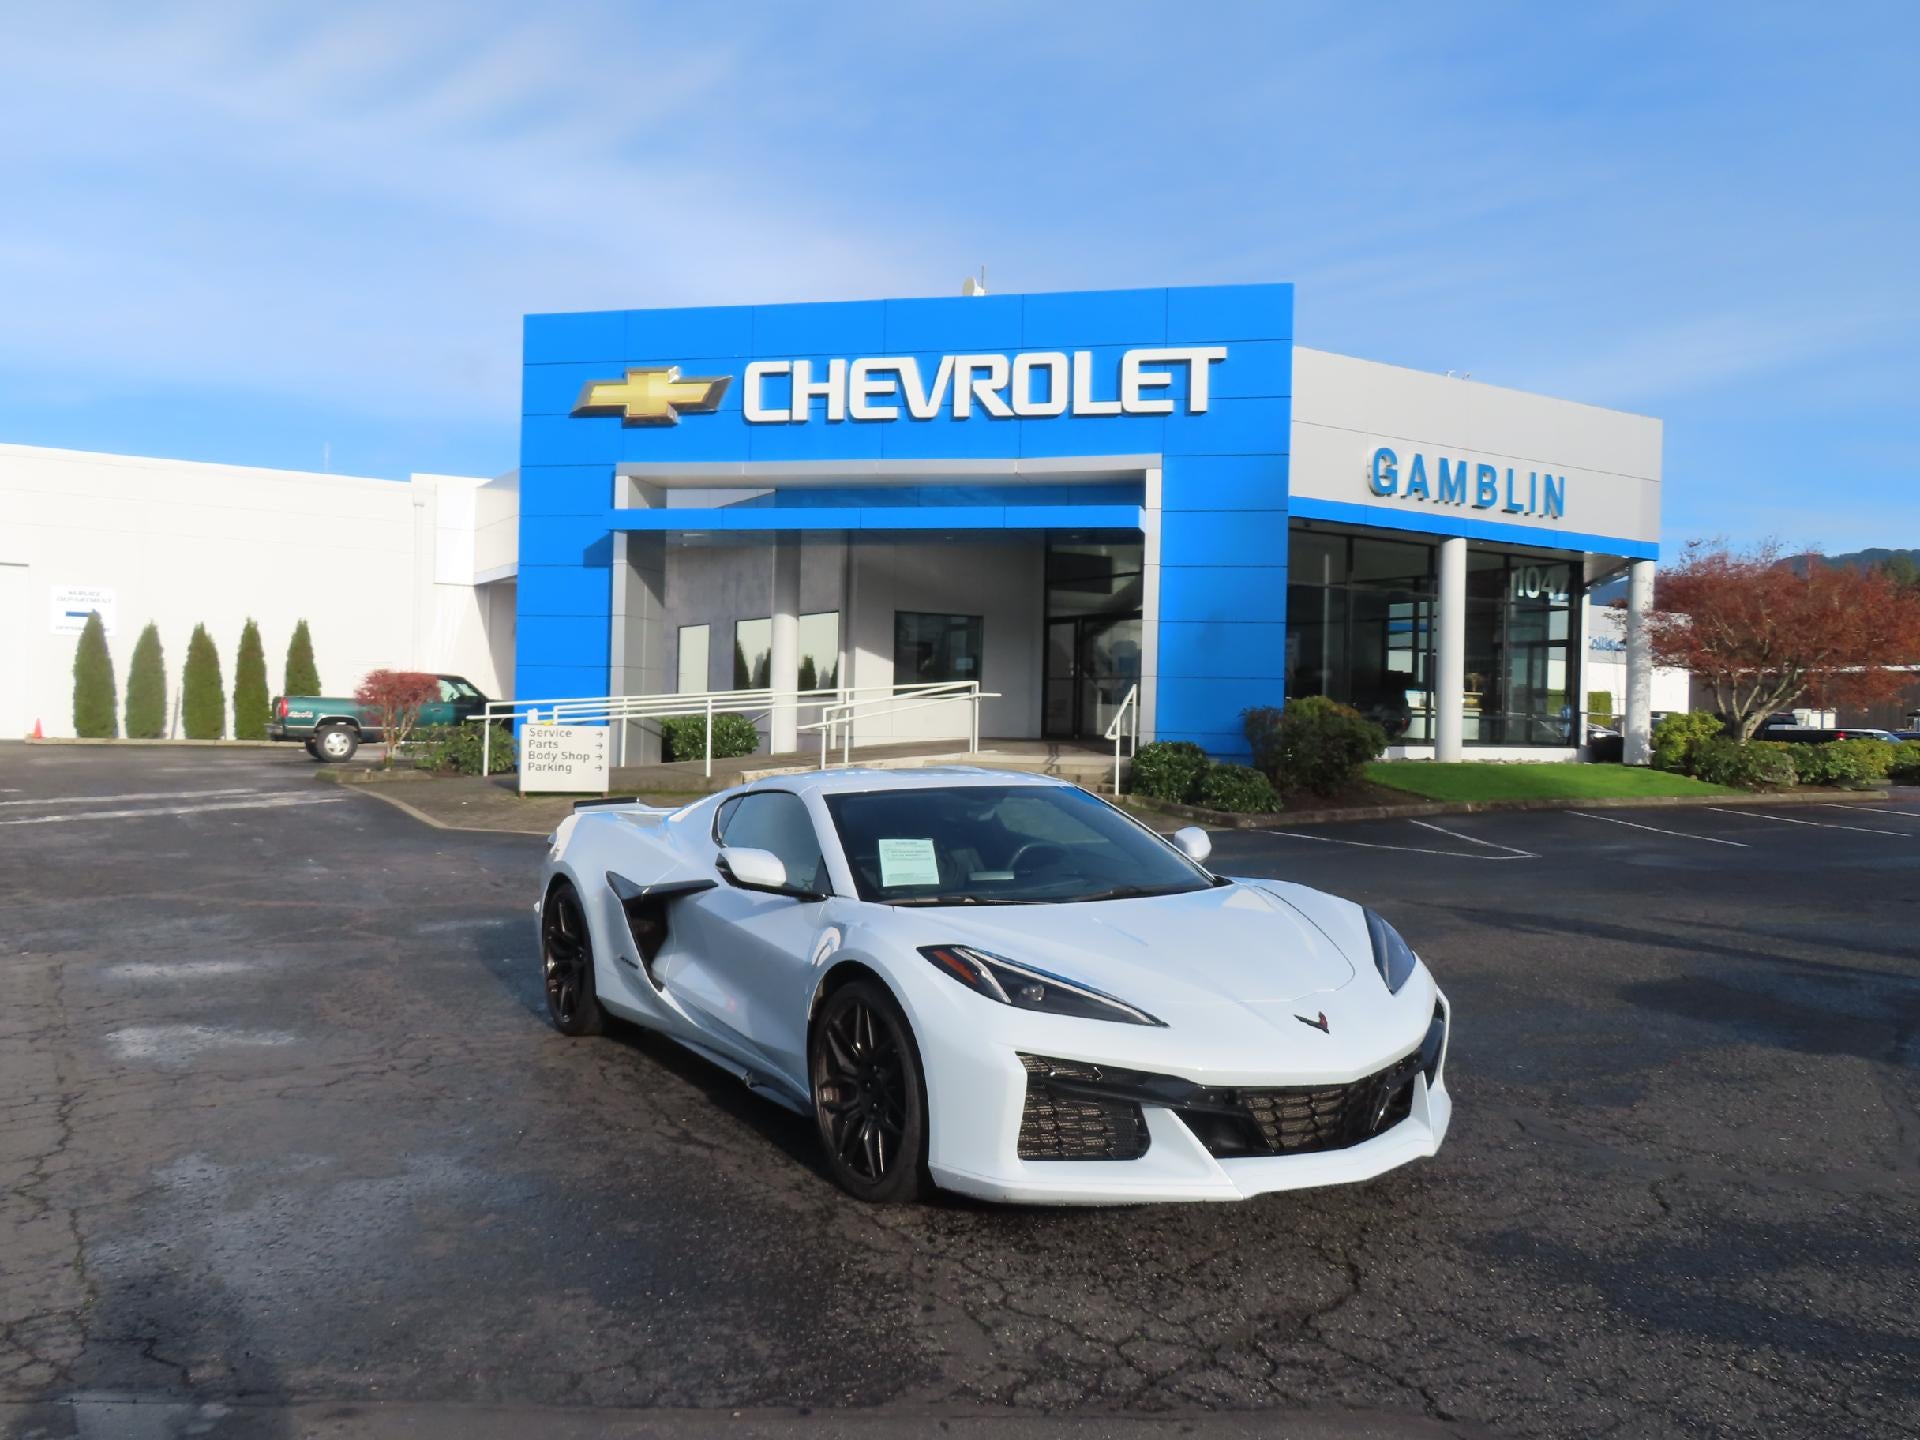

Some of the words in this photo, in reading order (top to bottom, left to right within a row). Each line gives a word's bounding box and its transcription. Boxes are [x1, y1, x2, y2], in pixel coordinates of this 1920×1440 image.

[743, 346, 1228, 423] CHEVROLET
[1370, 447, 1565, 518] GAMBLIN
[529, 727, 573, 737] Service
[528, 739, 559, 749] Parts
[528, 751, 558, 762] Body
[561, 751, 590, 762] Shop
[528, 763, 573, 774] Parking
